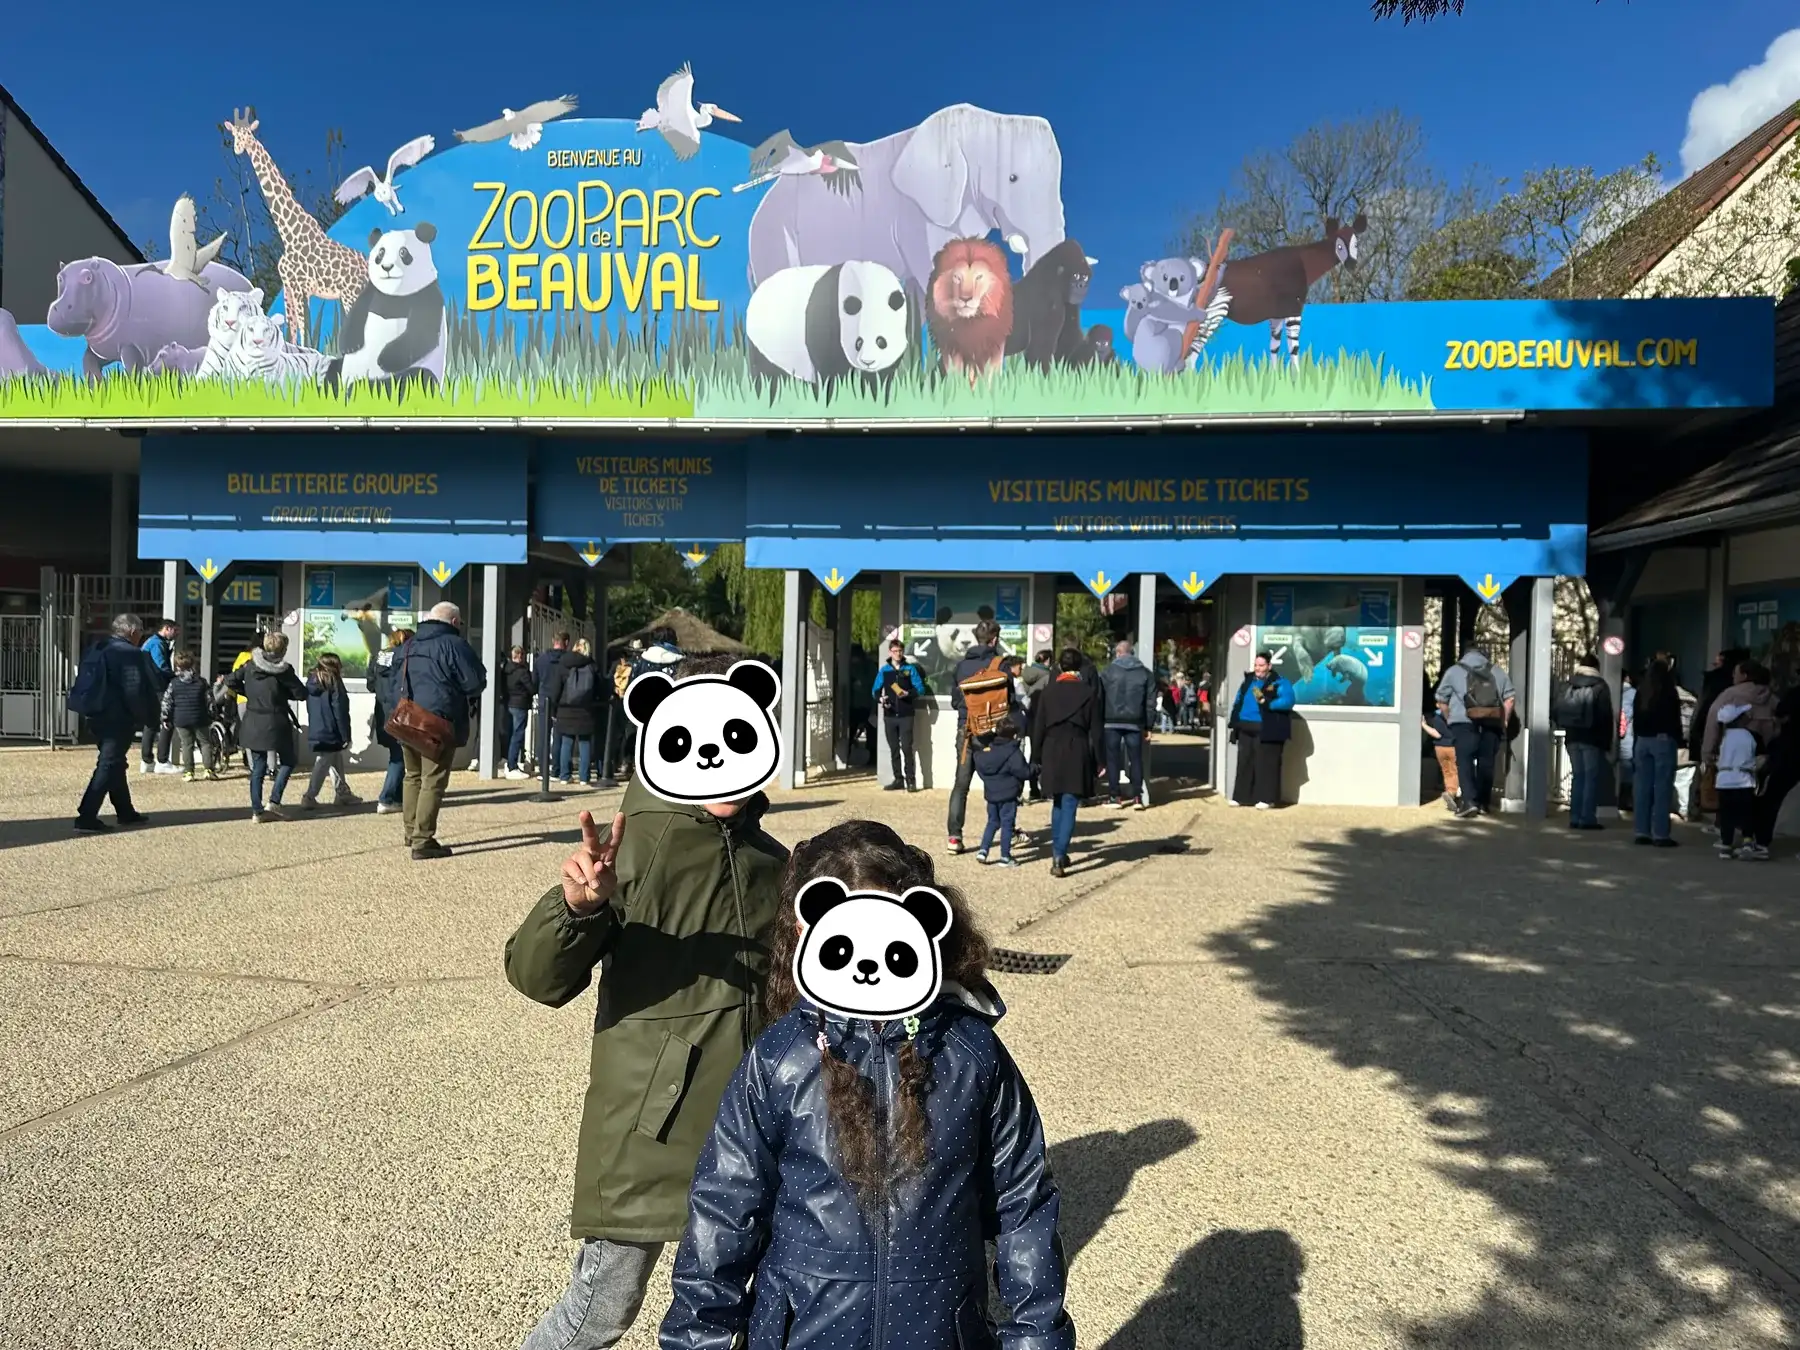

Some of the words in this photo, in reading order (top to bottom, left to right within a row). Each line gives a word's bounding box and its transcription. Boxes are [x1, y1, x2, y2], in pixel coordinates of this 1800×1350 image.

[547, 150, 620, 168] BIENVENUE
[623, 148, 643, 167] AU
[590, 227, 612, 247] de
[467, 252, 720, 312] BEAUVAL
[1444, 338, 1698, 370] ZOOBEAUVAL.COM
[576, 456, 659, 474] VISITEURS
[662, 456, 713, 474] MUNIS
[227, 473, 349, 495] BILLETTERIE
[352, 473, 439, 495] GROUPES
[600, 477, 619, 494] DE
[623, 477, 689, 495] TICKETS
[988, 479, 1102, 502] VISITEURS
[1106, 479, 1177, 502] MUNIS
[1181, 479, 1209, 502] DE
[1215, 478, 1310, 502] TICKETS
[604, 496, 653, 511] VISITORS
[656, 496, 683, 511] WITH
[271, 506, 318, 524] GROUP
[321, 506, 393, 525] TICKETING
[622, 513, 664, 528] TICKETS
[1053, 515, 1123, 534] VISITORS
[1128, 515, 1171, 534] WITH
[1173, 515, 1237, 534] TICKETS
[187, 581, 262, 600] STIE
